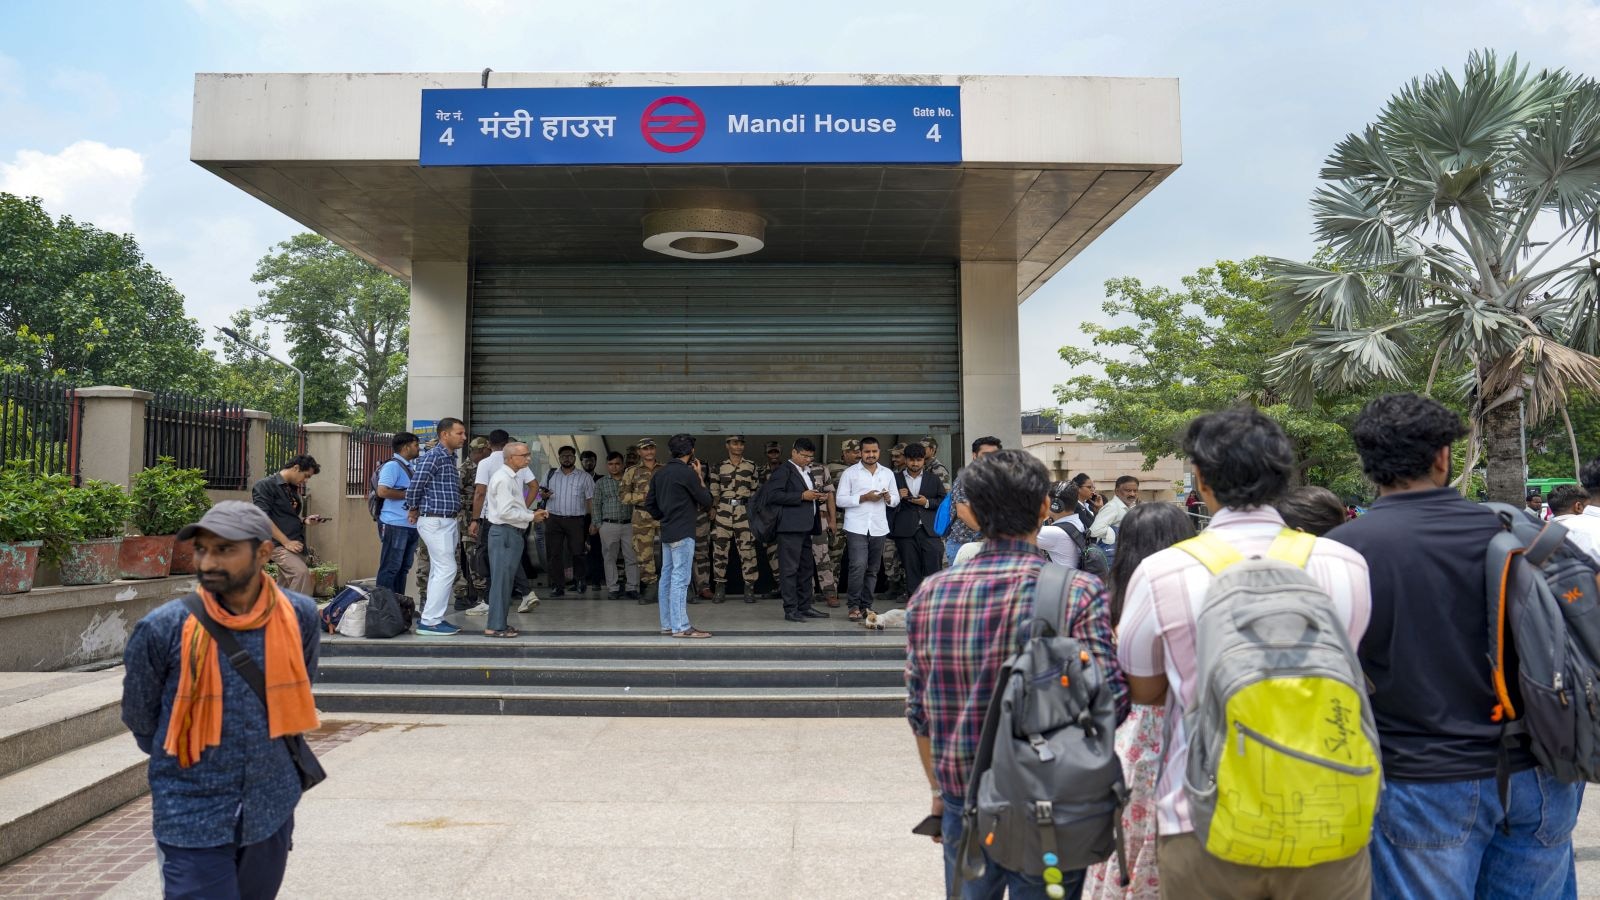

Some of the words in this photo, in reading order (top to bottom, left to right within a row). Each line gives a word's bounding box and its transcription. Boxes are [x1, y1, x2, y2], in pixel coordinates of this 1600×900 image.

[435, 110, 451, 121] गेट
[913, 107, 935, 117] Gate
[938, 107, 954, 117] No.
[478, 109, 534, 138] मंडी
[540, 116, 617, 141] हाउस
[728, 114, 805, 133] Mandi
[814, 114, 897, 133] House
[926, 123, 942, 143] 4
[439, 127, 455, 146] 4
